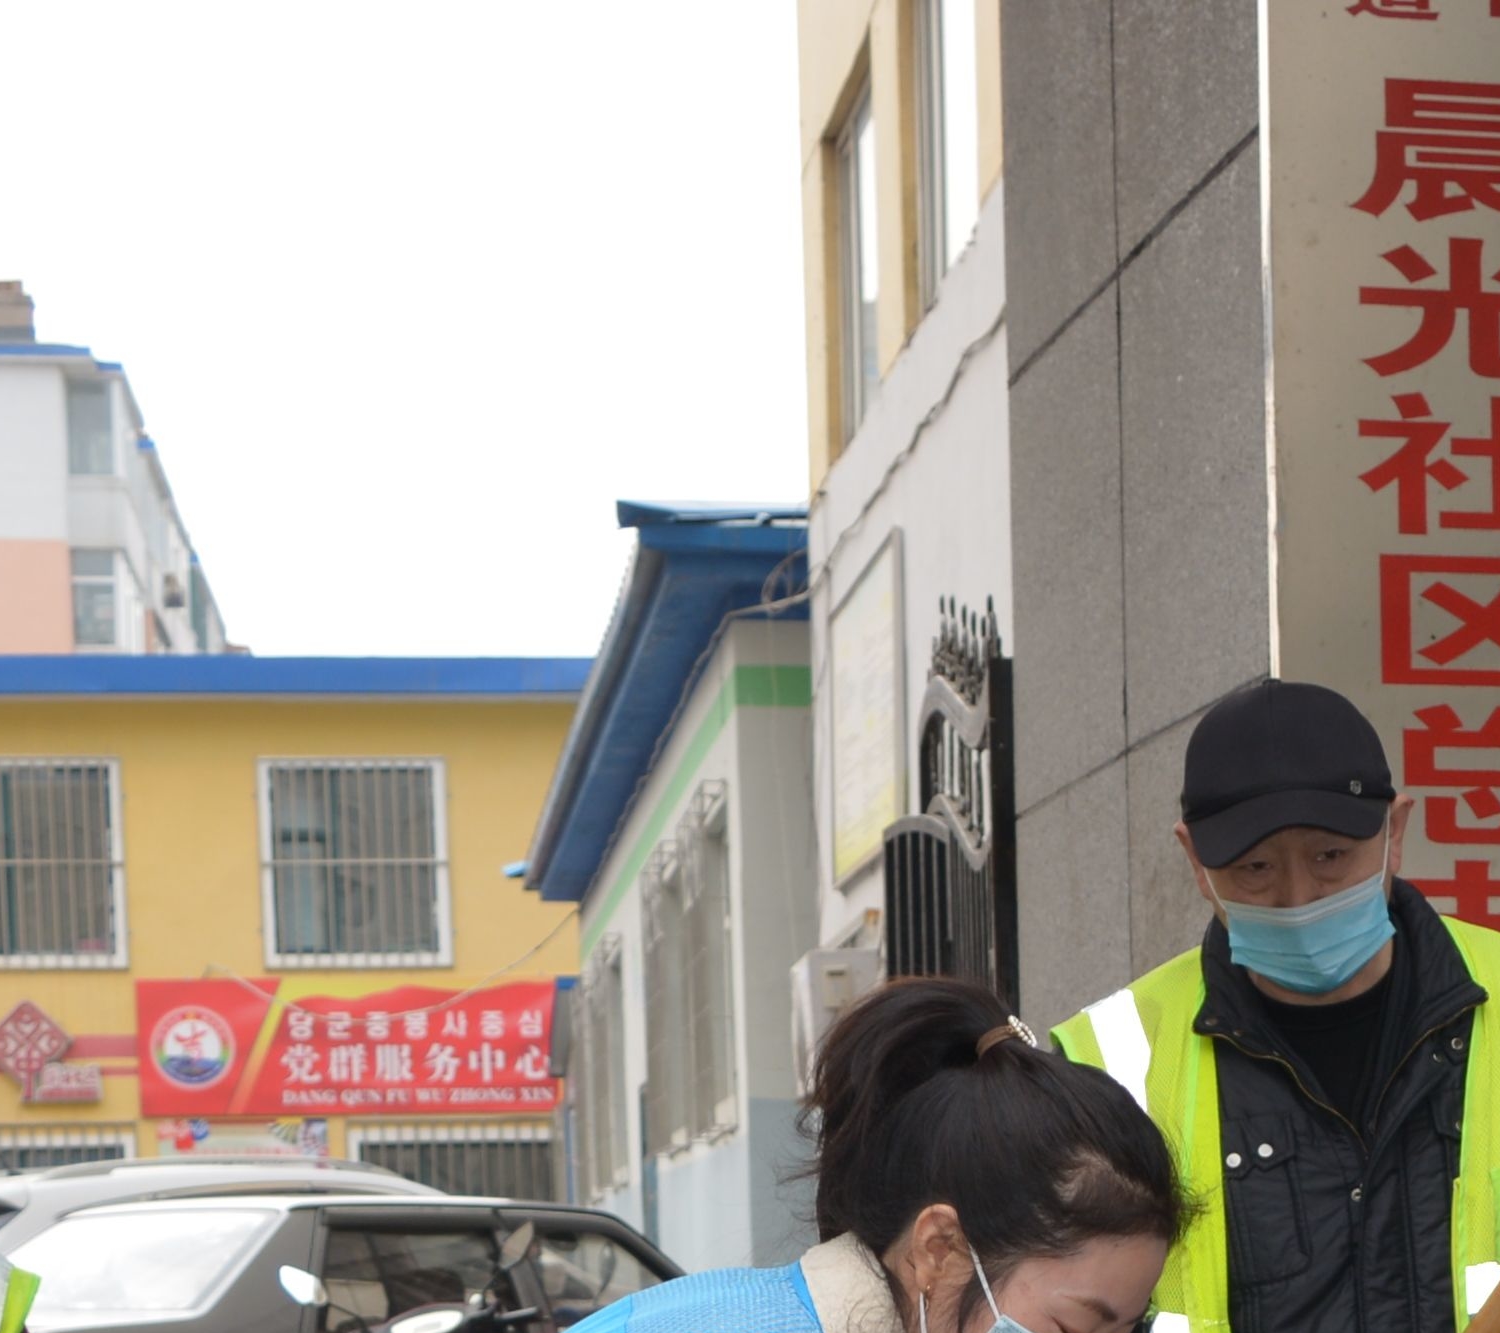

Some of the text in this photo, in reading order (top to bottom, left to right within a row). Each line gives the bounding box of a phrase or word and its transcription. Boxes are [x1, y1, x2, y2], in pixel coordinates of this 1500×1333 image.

[280, 1042, 550, 1084] 党群服务中心
[282, 1085, 554, 1106] DANG QUN FU WU ZHONG XIN
